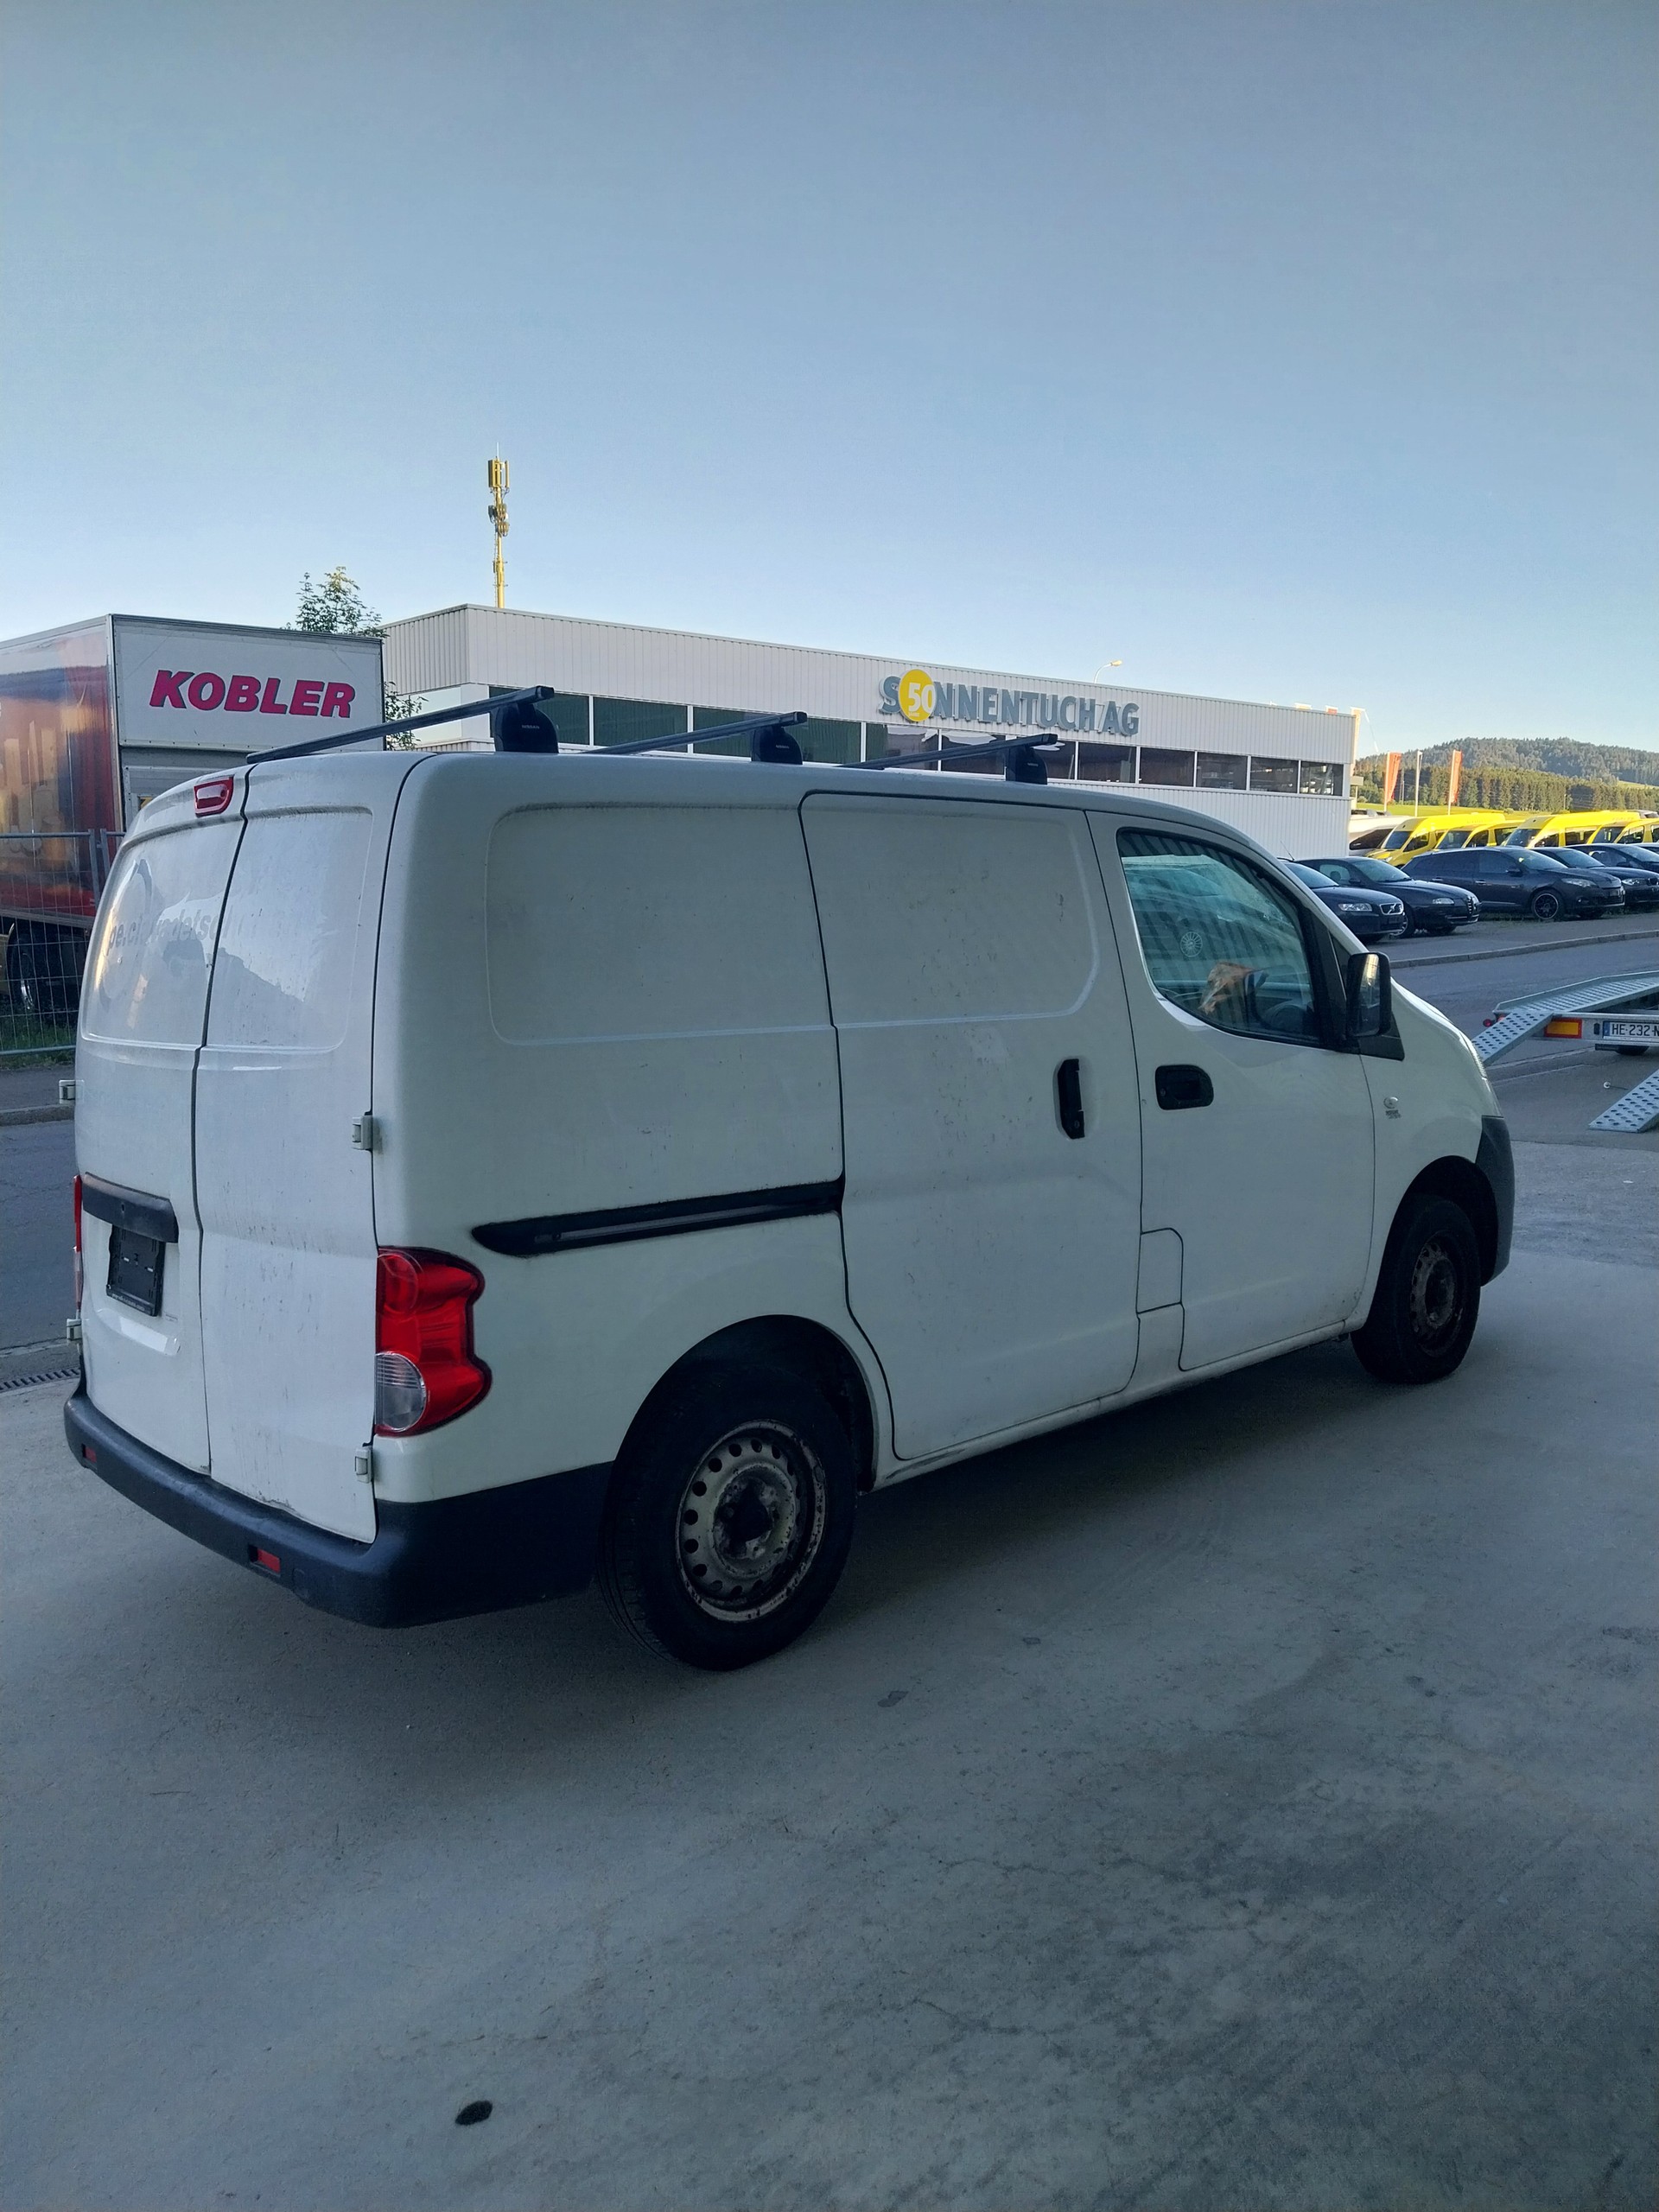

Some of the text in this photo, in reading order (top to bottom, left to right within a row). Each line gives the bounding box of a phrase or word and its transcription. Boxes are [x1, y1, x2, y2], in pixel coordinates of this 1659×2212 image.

[149, 670, 356, 718] KOBLER
[879, 676, 1140, 736] SNNENTUCH AG
[908, 683, 936, 714] 50
